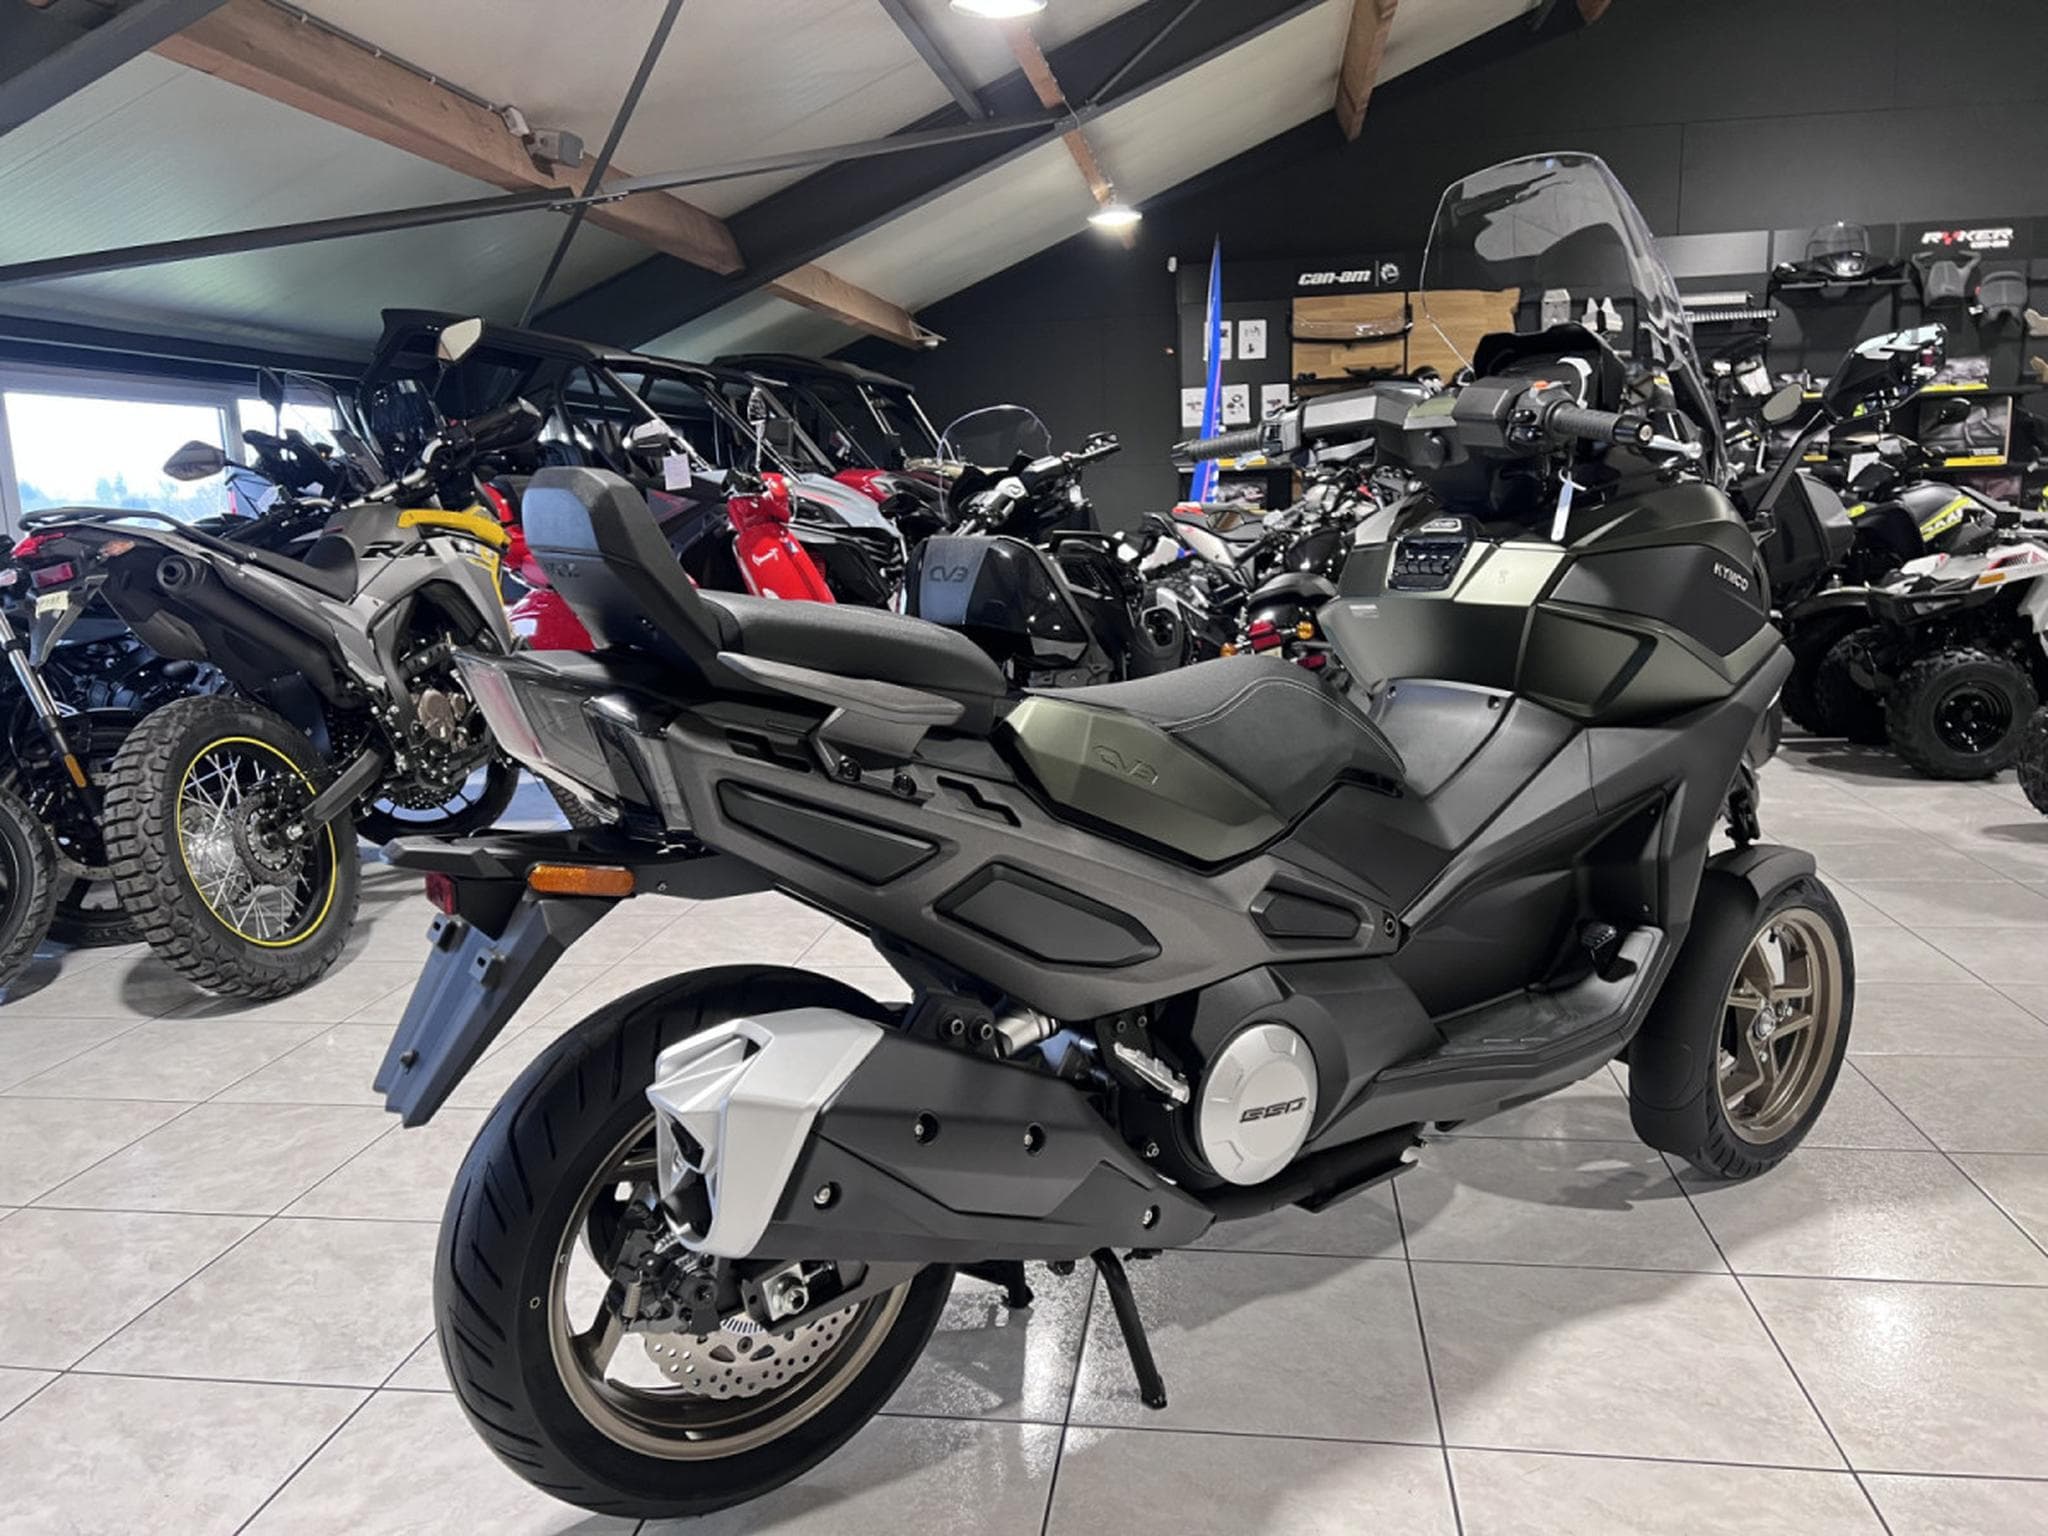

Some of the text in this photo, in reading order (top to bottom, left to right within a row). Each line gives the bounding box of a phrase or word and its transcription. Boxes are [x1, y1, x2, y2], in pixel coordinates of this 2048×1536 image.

[929, 565, 969, 583] CV3
[1713, 561, 1749, 592] KYMCO
[1092, 744, 1159, 785] CV3
